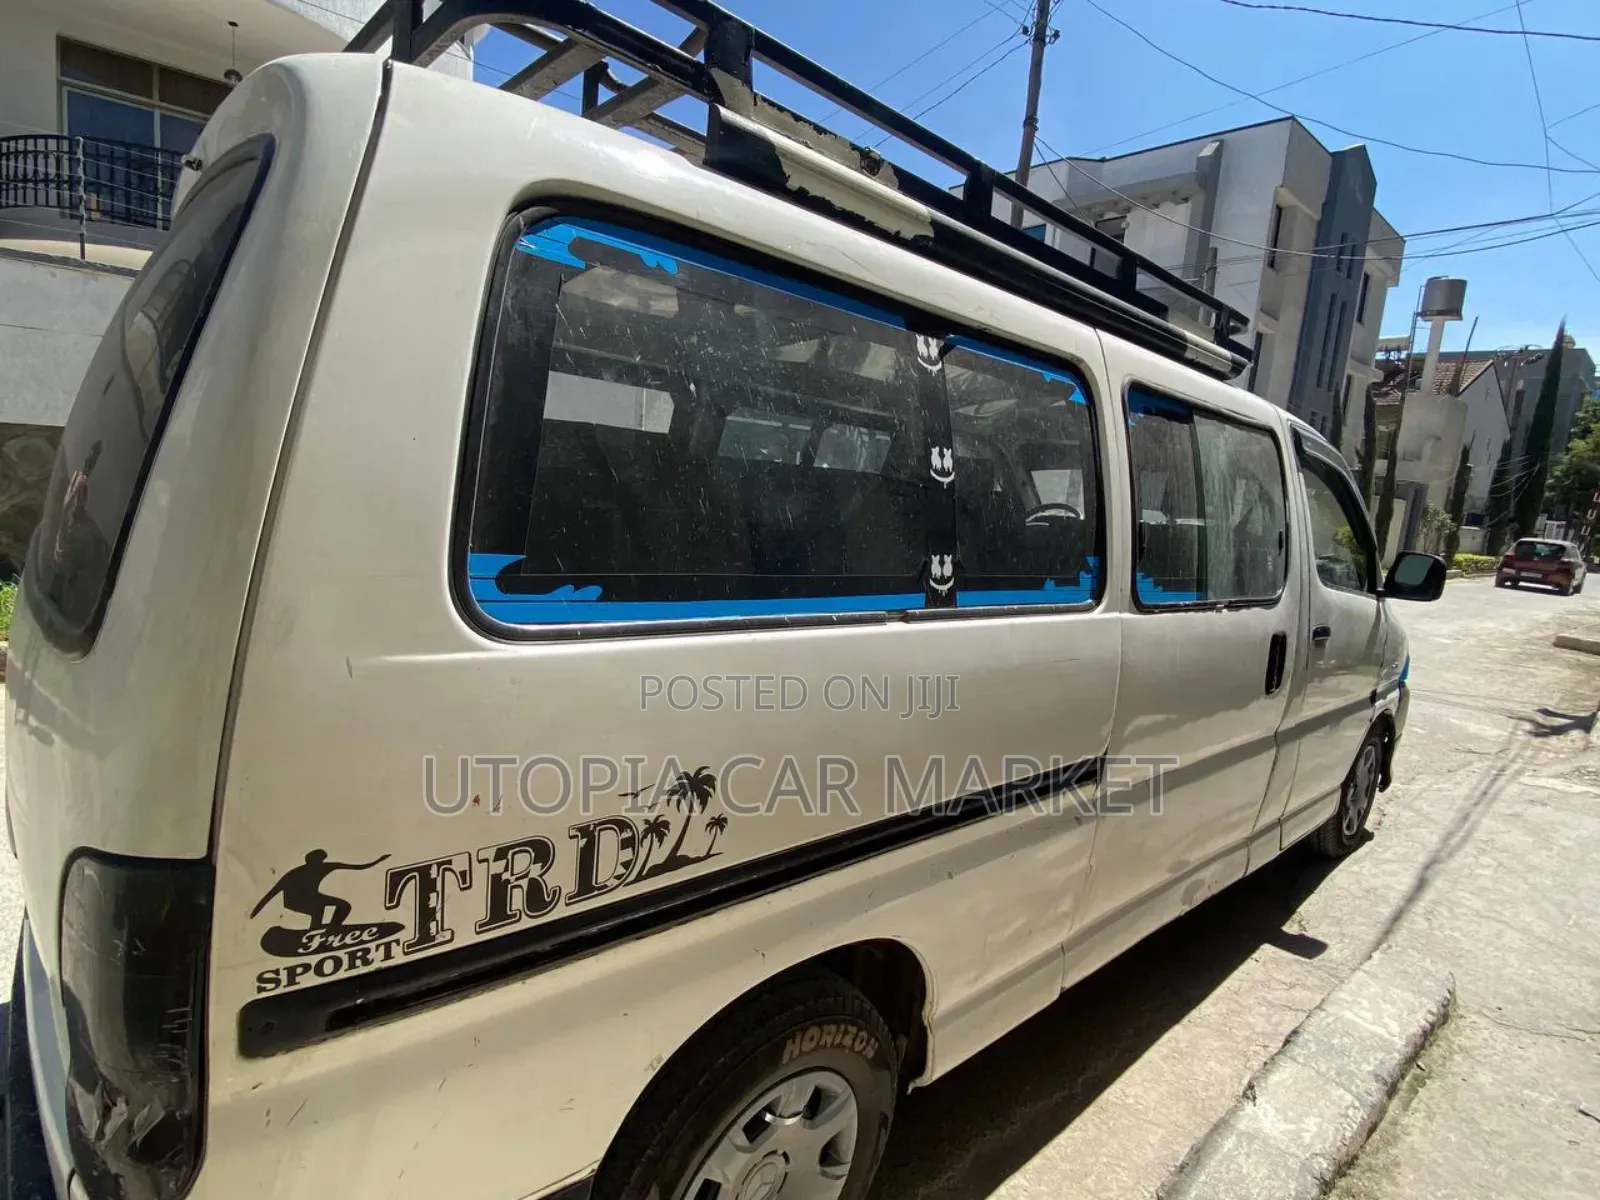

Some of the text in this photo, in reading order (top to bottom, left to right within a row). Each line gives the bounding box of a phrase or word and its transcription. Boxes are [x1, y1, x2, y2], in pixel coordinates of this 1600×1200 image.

[385, 815, 641, 956] TRD
[297, 926, 380, 953] Free
[256, 939, 401, 994] SPORT
[781, 1023, 880, 1065] HORIZON
